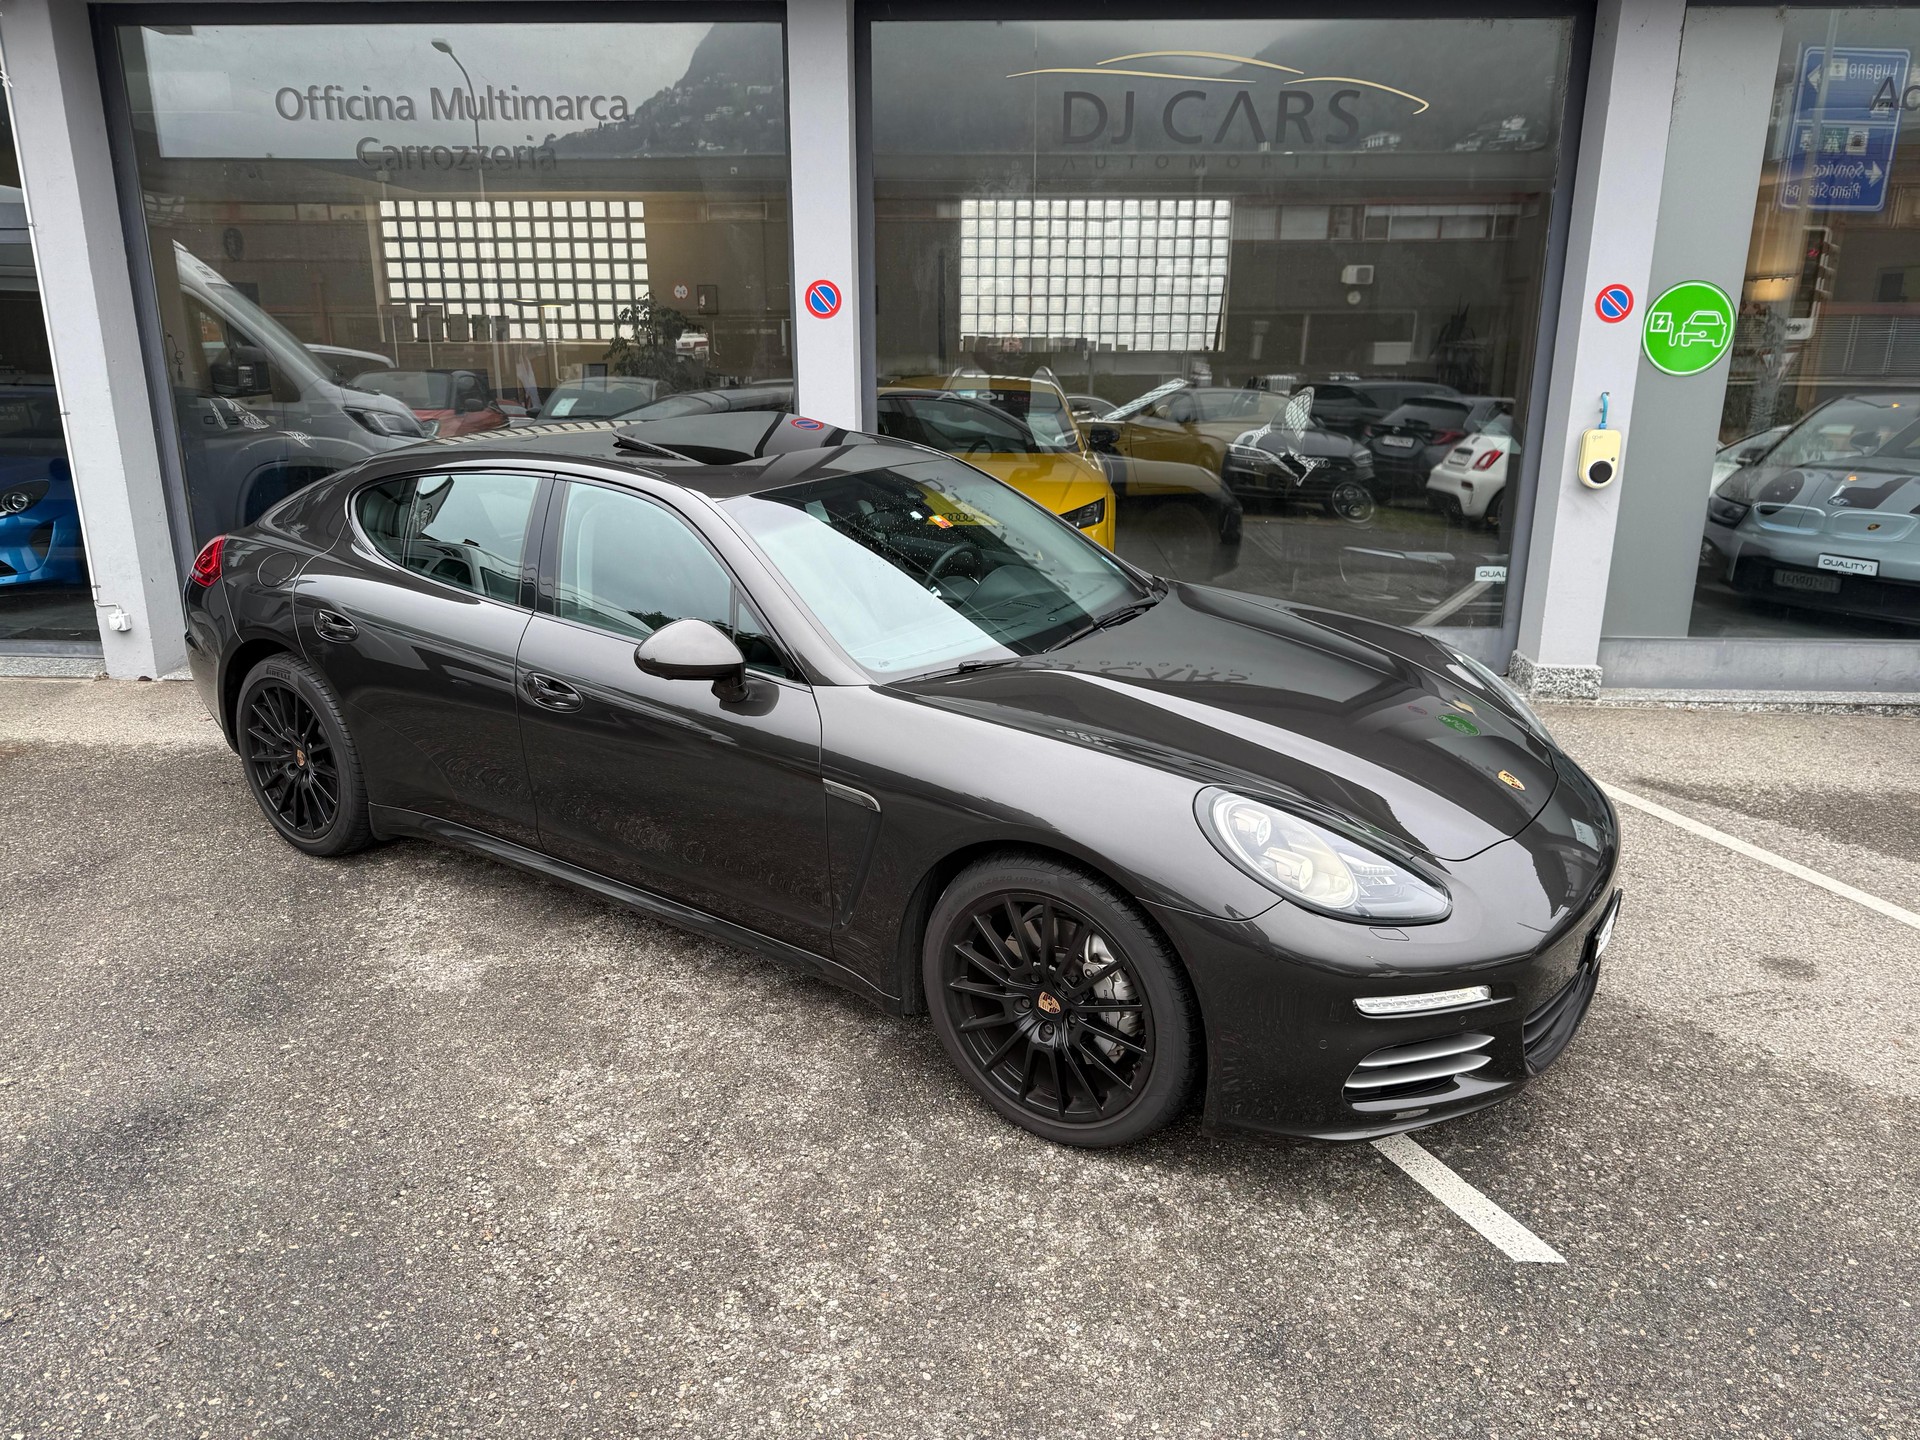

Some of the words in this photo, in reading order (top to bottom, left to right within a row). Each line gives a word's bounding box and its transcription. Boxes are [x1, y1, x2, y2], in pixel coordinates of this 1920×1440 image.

[275, 85, 417, 121] Officina
[430, 85, 630, 121] Multimarca
[1062, 90, 1135, 145] DJ
[1162, 90, 1361, 145] CARS
[355, 135, 557, 171] Carrozzeria
[1061, 154, 1361, 170] AUTOMOBILI
[1823, 558, 1867, 571] QUALITY
[266, 665, 291, 681] PIRELLI
